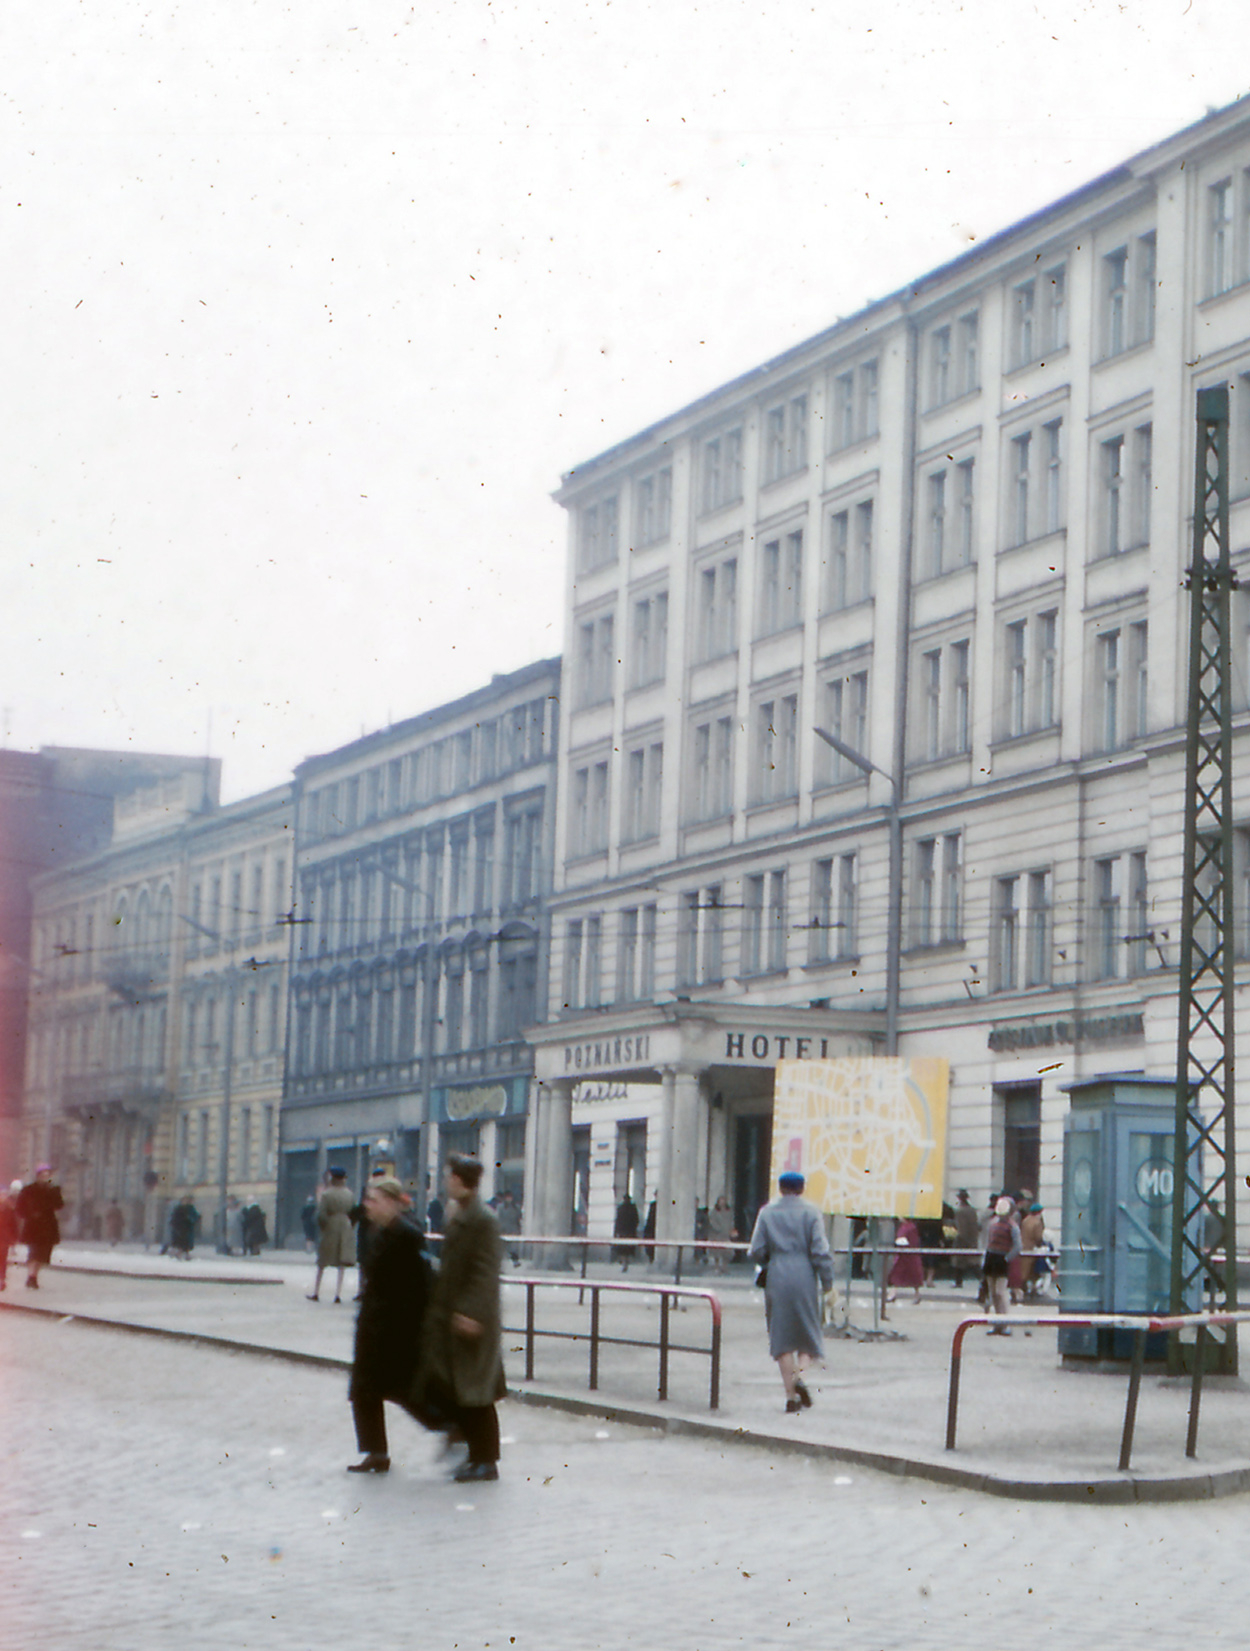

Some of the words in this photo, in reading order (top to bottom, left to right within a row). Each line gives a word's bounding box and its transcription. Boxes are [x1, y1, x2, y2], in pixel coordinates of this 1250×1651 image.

[564, 1035, 650, 1071] POZNAŃSKI
[726, 1032, 836, 1060] HOTEL
[1140, 1168, 1174, 1196] MO
